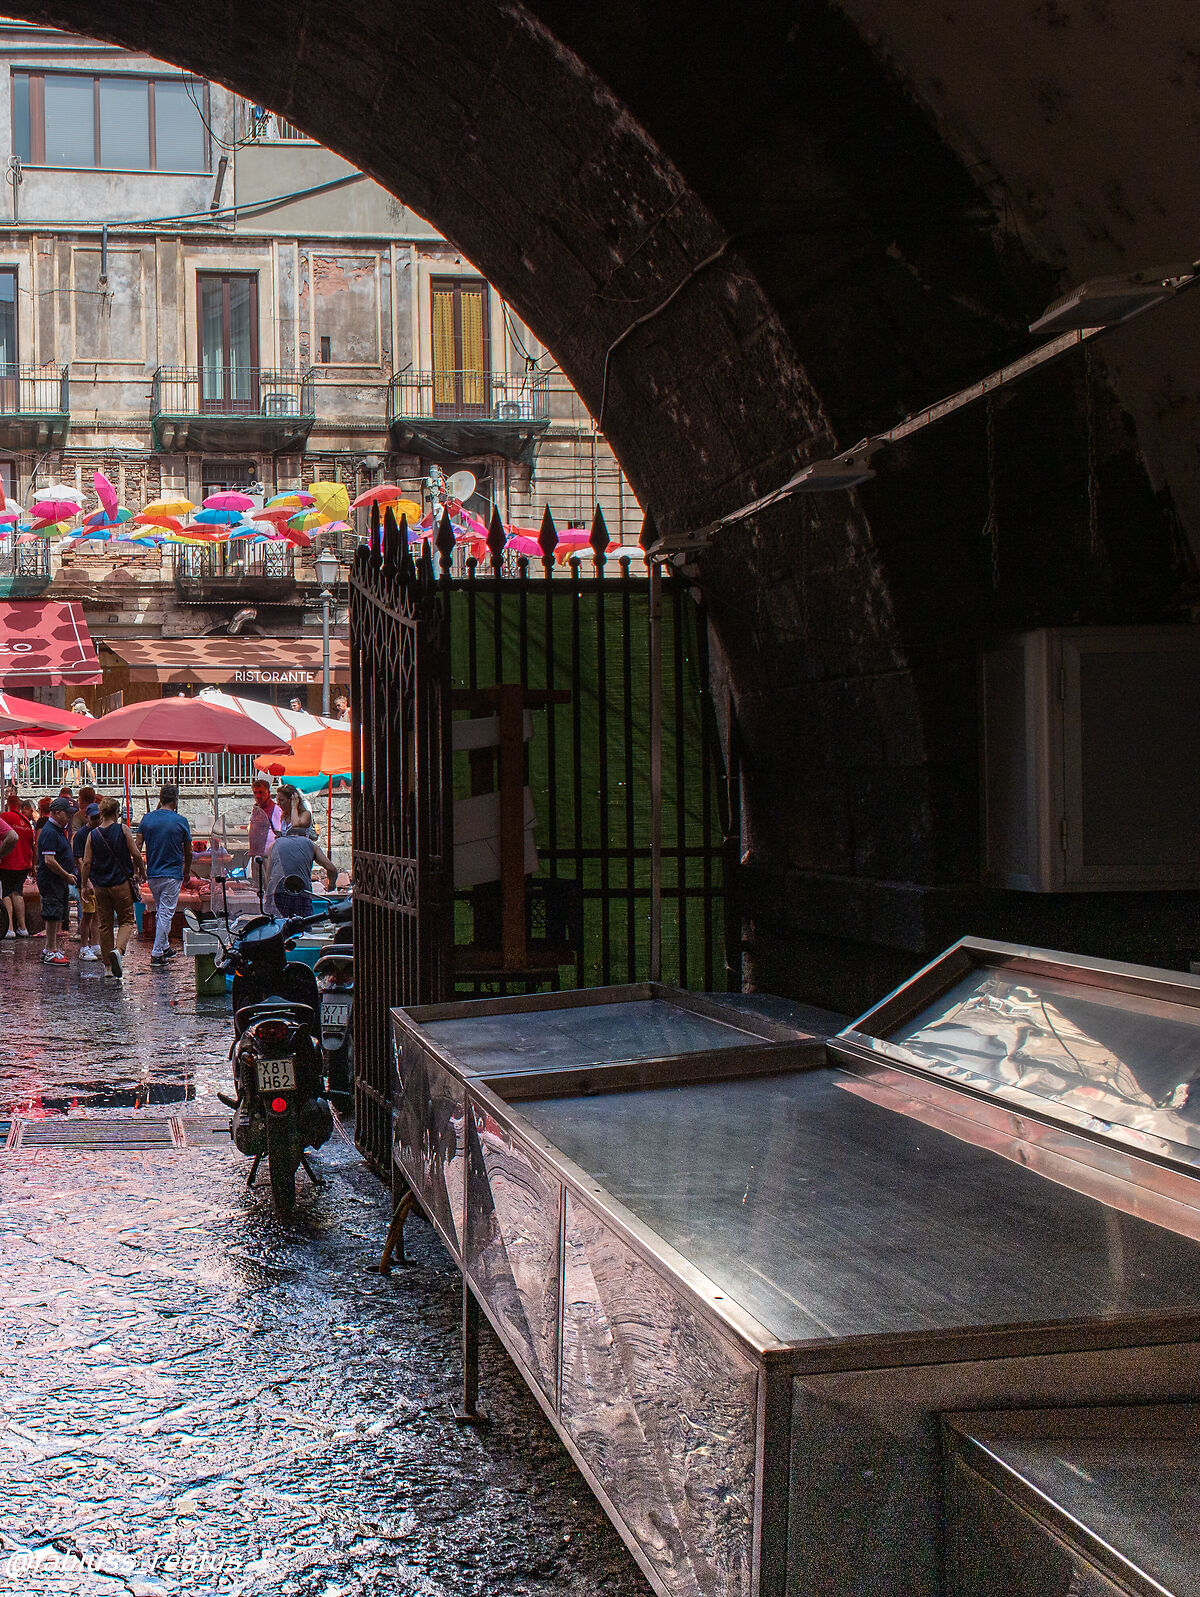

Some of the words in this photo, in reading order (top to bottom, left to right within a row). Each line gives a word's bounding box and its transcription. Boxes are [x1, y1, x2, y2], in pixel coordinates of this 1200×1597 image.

[235, 671, 315, 683] RISTORANTE
[324, 1005, 346, 1015] X7T
[323, 1015, 344, 1024] WLL
[262, 1061, 290, 1075] X8T
[263, 1075, 291, 1089] H62
